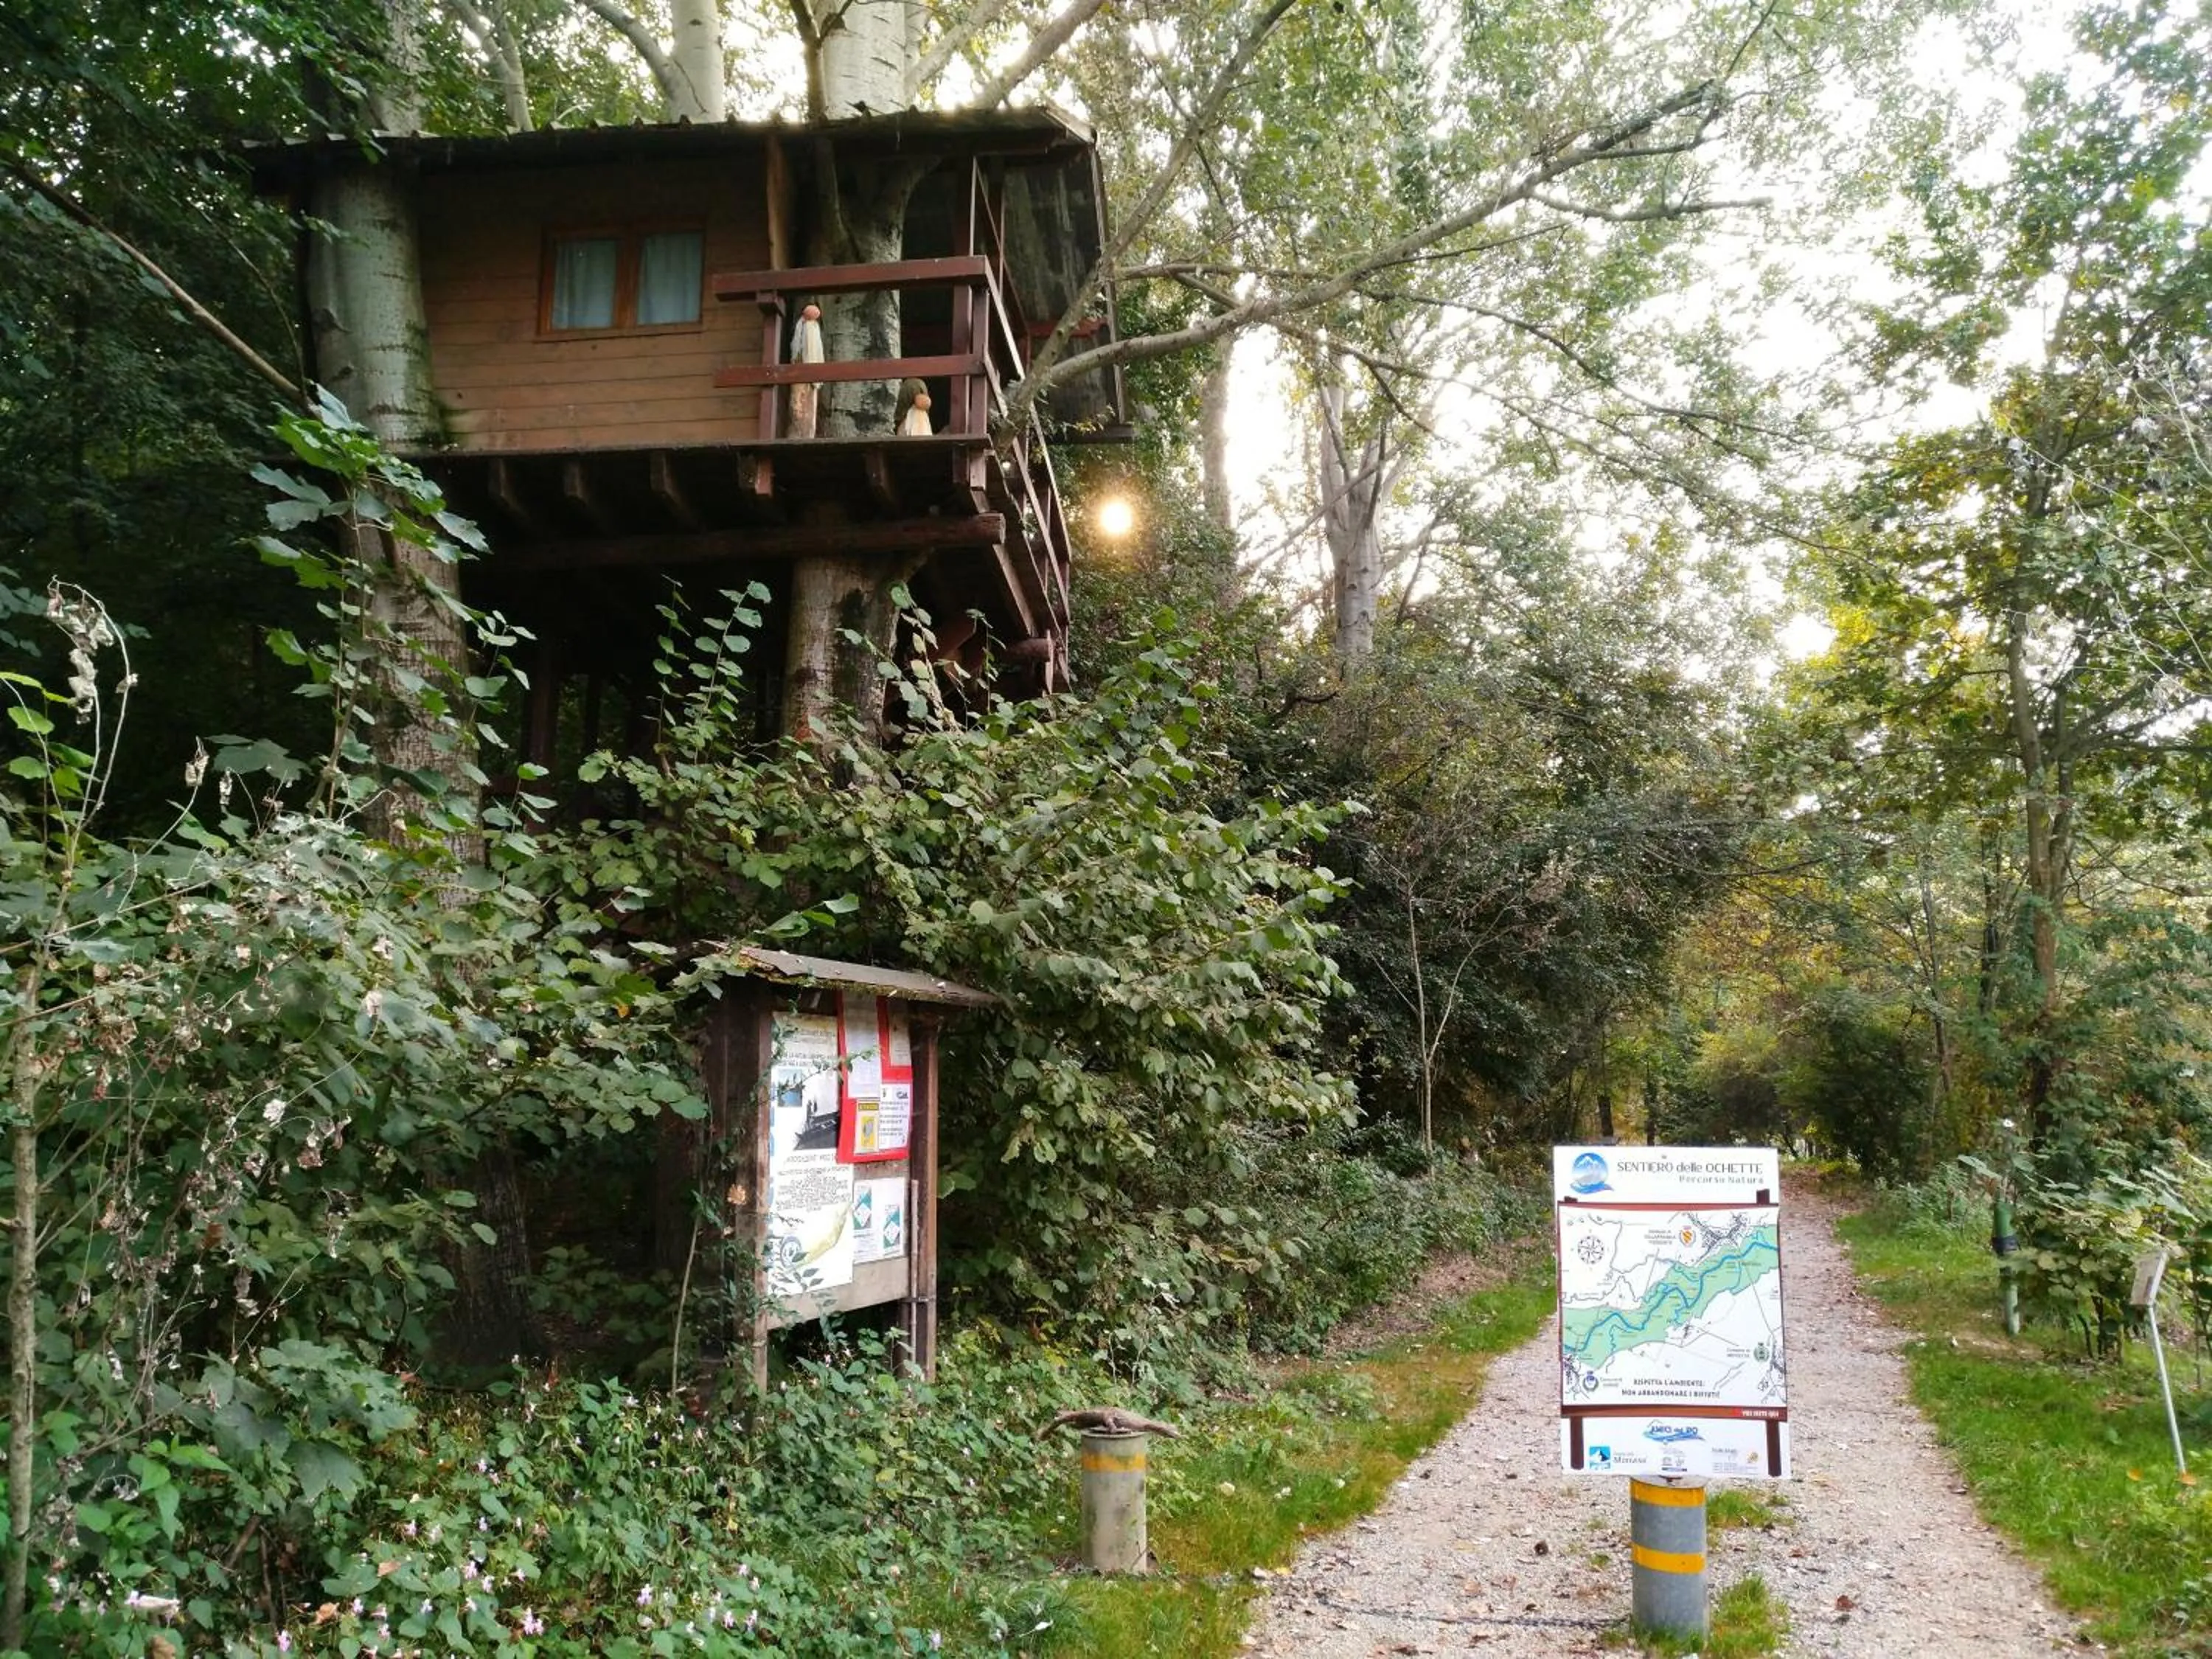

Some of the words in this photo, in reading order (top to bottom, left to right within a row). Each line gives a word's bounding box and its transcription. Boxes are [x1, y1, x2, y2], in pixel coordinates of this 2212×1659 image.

[1617, 1161, 1674, 1173] SENTIERO
[1676, 1162, 1703, 1173] delle
[1705, 1163, 1763, 1174] OCHETTE
[1679, 1175, 1725, 1183] Percorso
[1728, 1176, 1764, 1184] Natura
